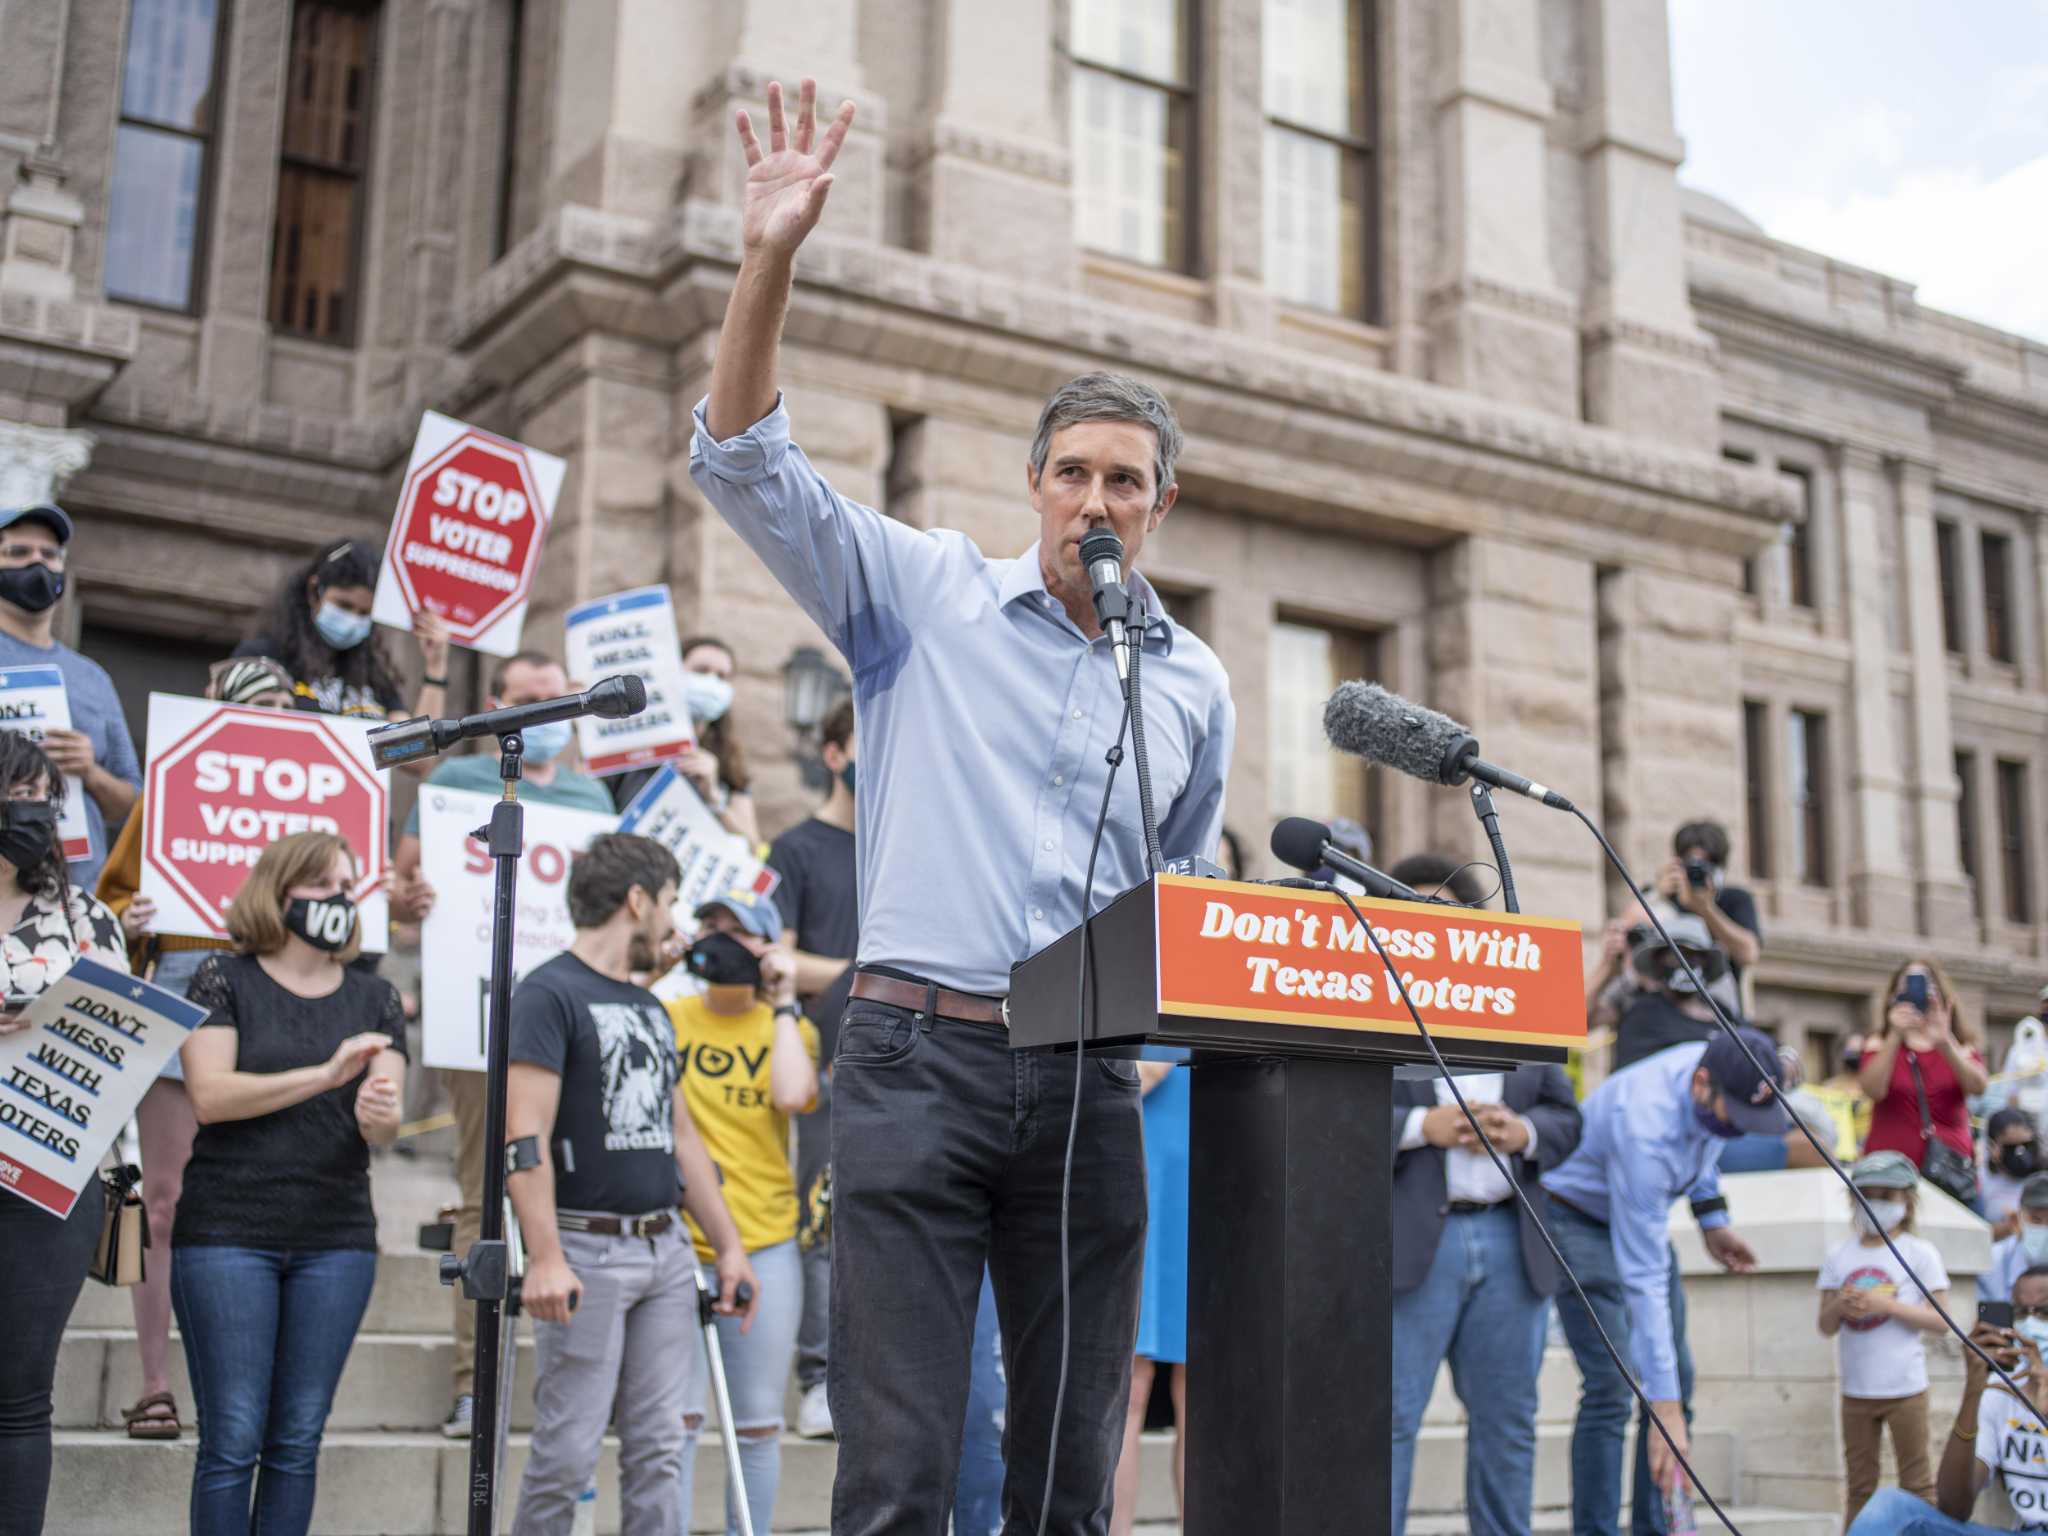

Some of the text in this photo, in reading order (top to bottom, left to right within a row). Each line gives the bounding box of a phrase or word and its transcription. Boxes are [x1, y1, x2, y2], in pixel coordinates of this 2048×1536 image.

[433, 467, 528, 526] STOP
[429, 513, 512, 565] VOTER
[194, 750, 346, 804] STOP
[1200, 901, 1541, 971] Don't Mess With
[1246, 956, 1516, 1016] Texas Voters
[53, 1017, 125, 1065] MESS
[71, 996, 148, 1037] DON'T
[38, 1042, 103, 1091] WITH
[11, 1066, 91, 1127] TEXAS
[723, 1085, 769, 1109] TEX
[0, 1098, 80, 1159] OTERS
